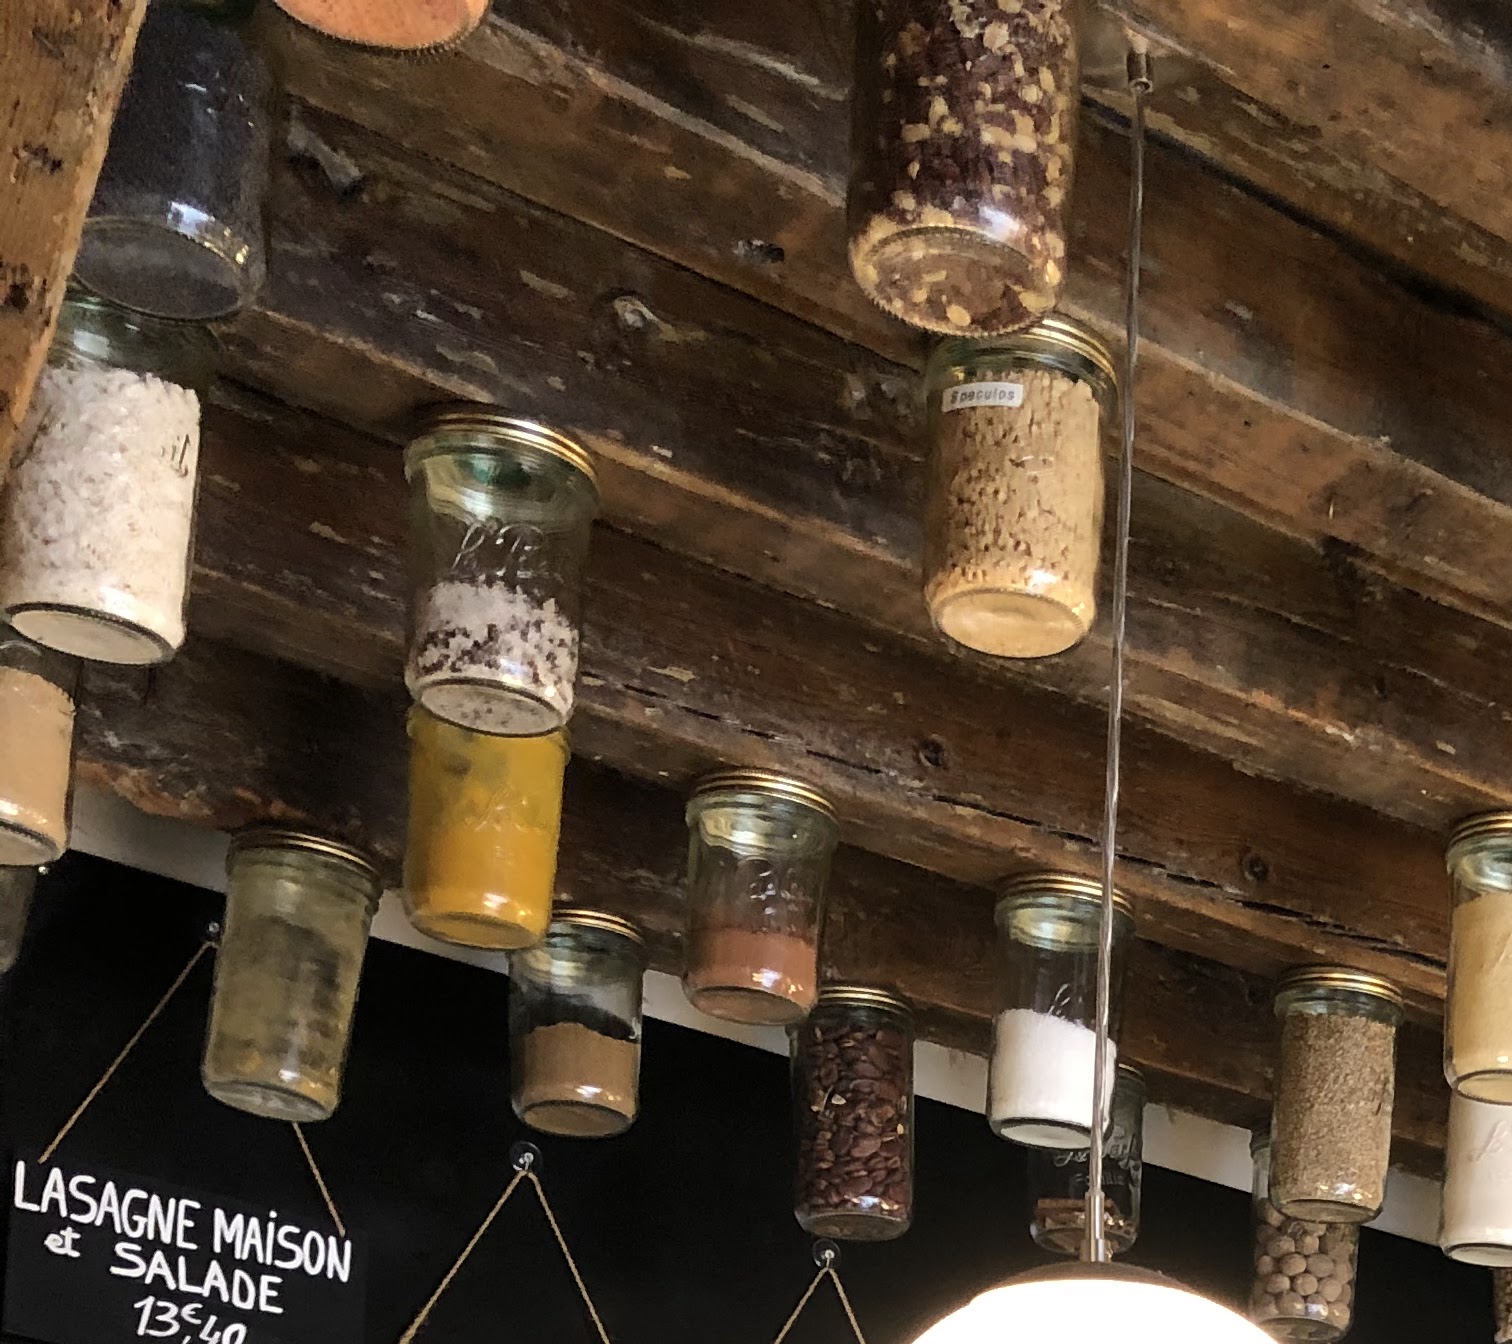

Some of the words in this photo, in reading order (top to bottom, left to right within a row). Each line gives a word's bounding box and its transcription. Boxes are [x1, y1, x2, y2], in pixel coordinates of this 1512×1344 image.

[14, 1161, 200, 1250] LASAGNE
[44, 1227, 81, 1259] et
[110, 1242, 284, 1314] SALADE
